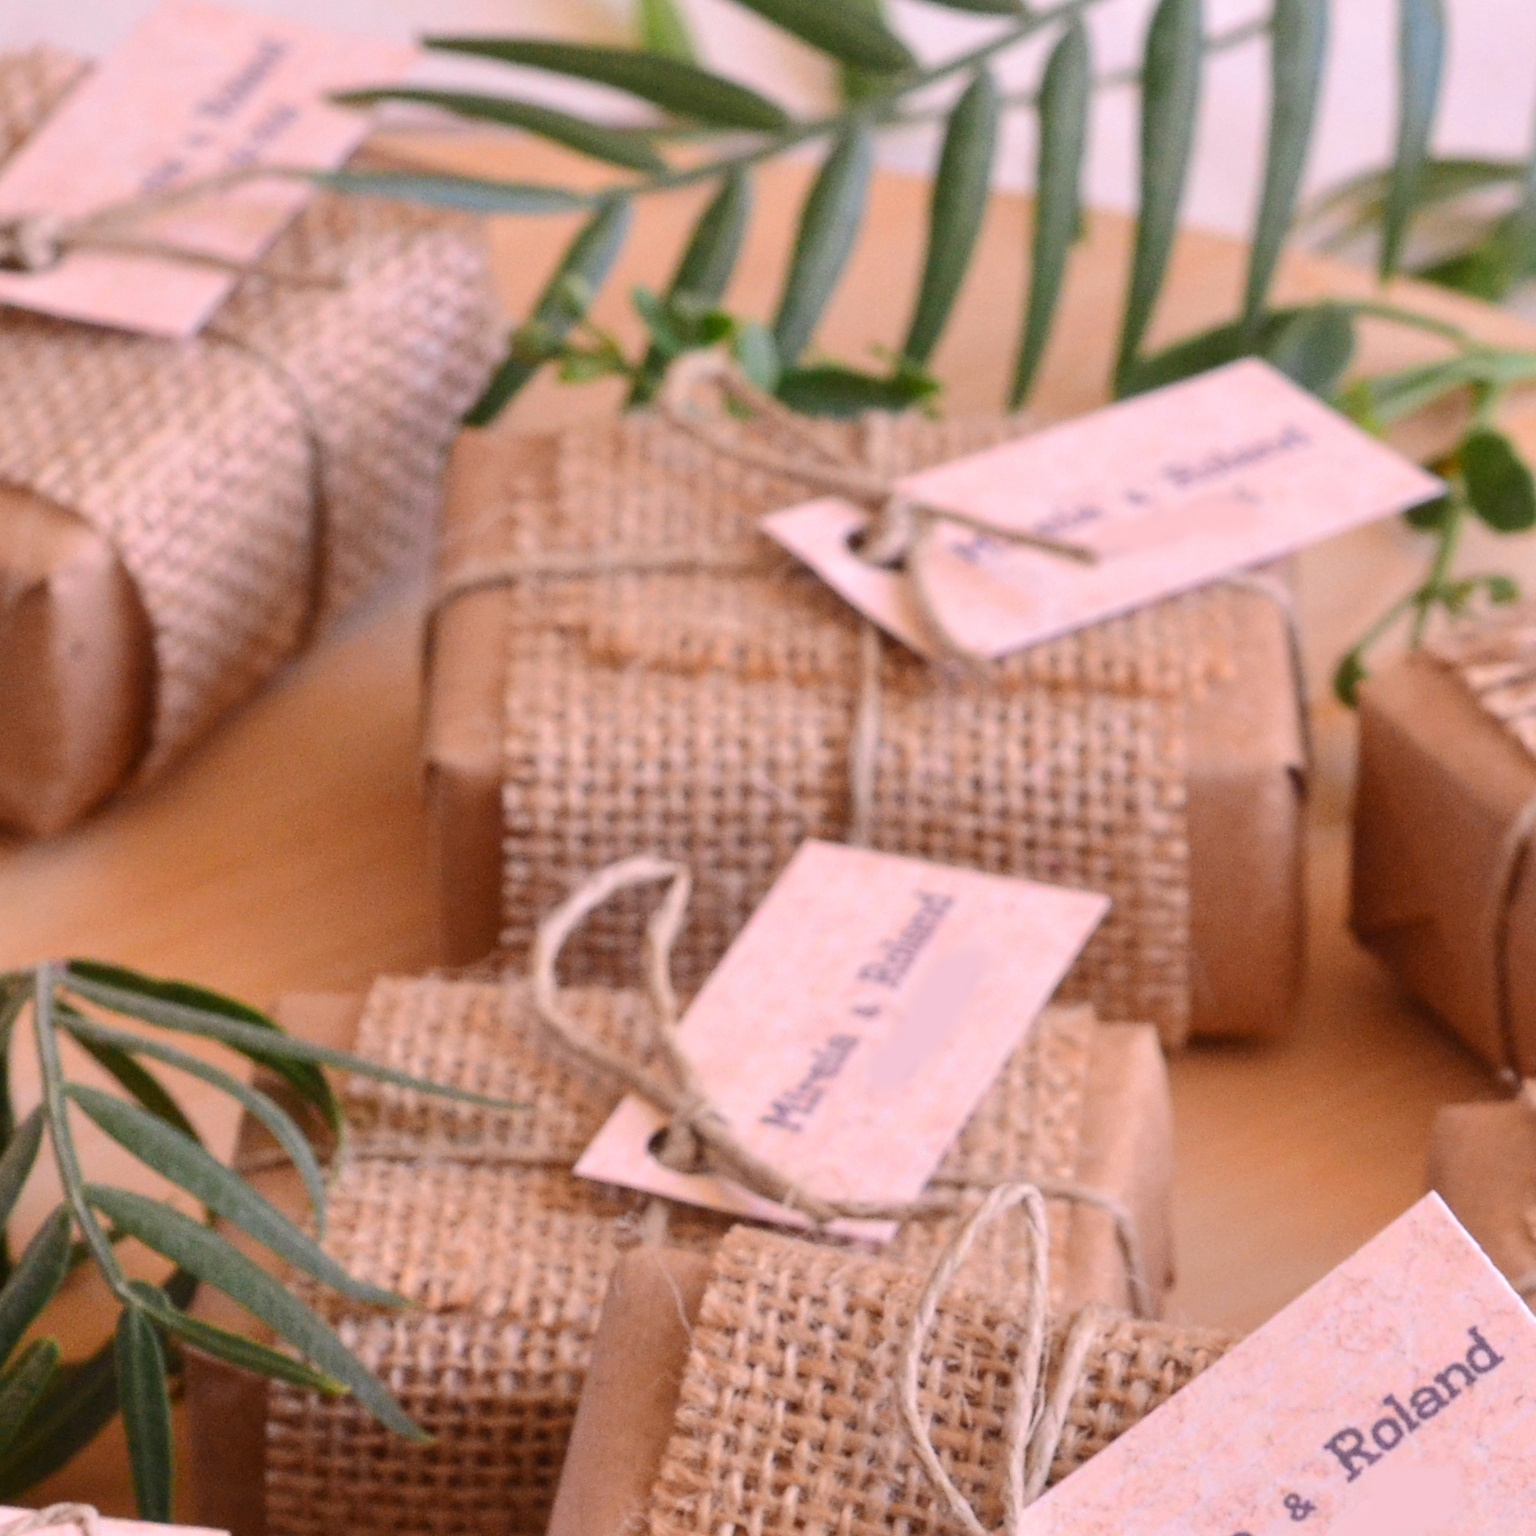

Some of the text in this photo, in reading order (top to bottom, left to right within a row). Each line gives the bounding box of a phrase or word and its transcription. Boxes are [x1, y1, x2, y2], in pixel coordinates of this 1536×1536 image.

[761, 1034, 857, 1132] Mireia
[859, 891, 953, 988] Roland
[1283, 1493, 1317, 1521] &
[1324, 1327, 1505, 1482] Roland
